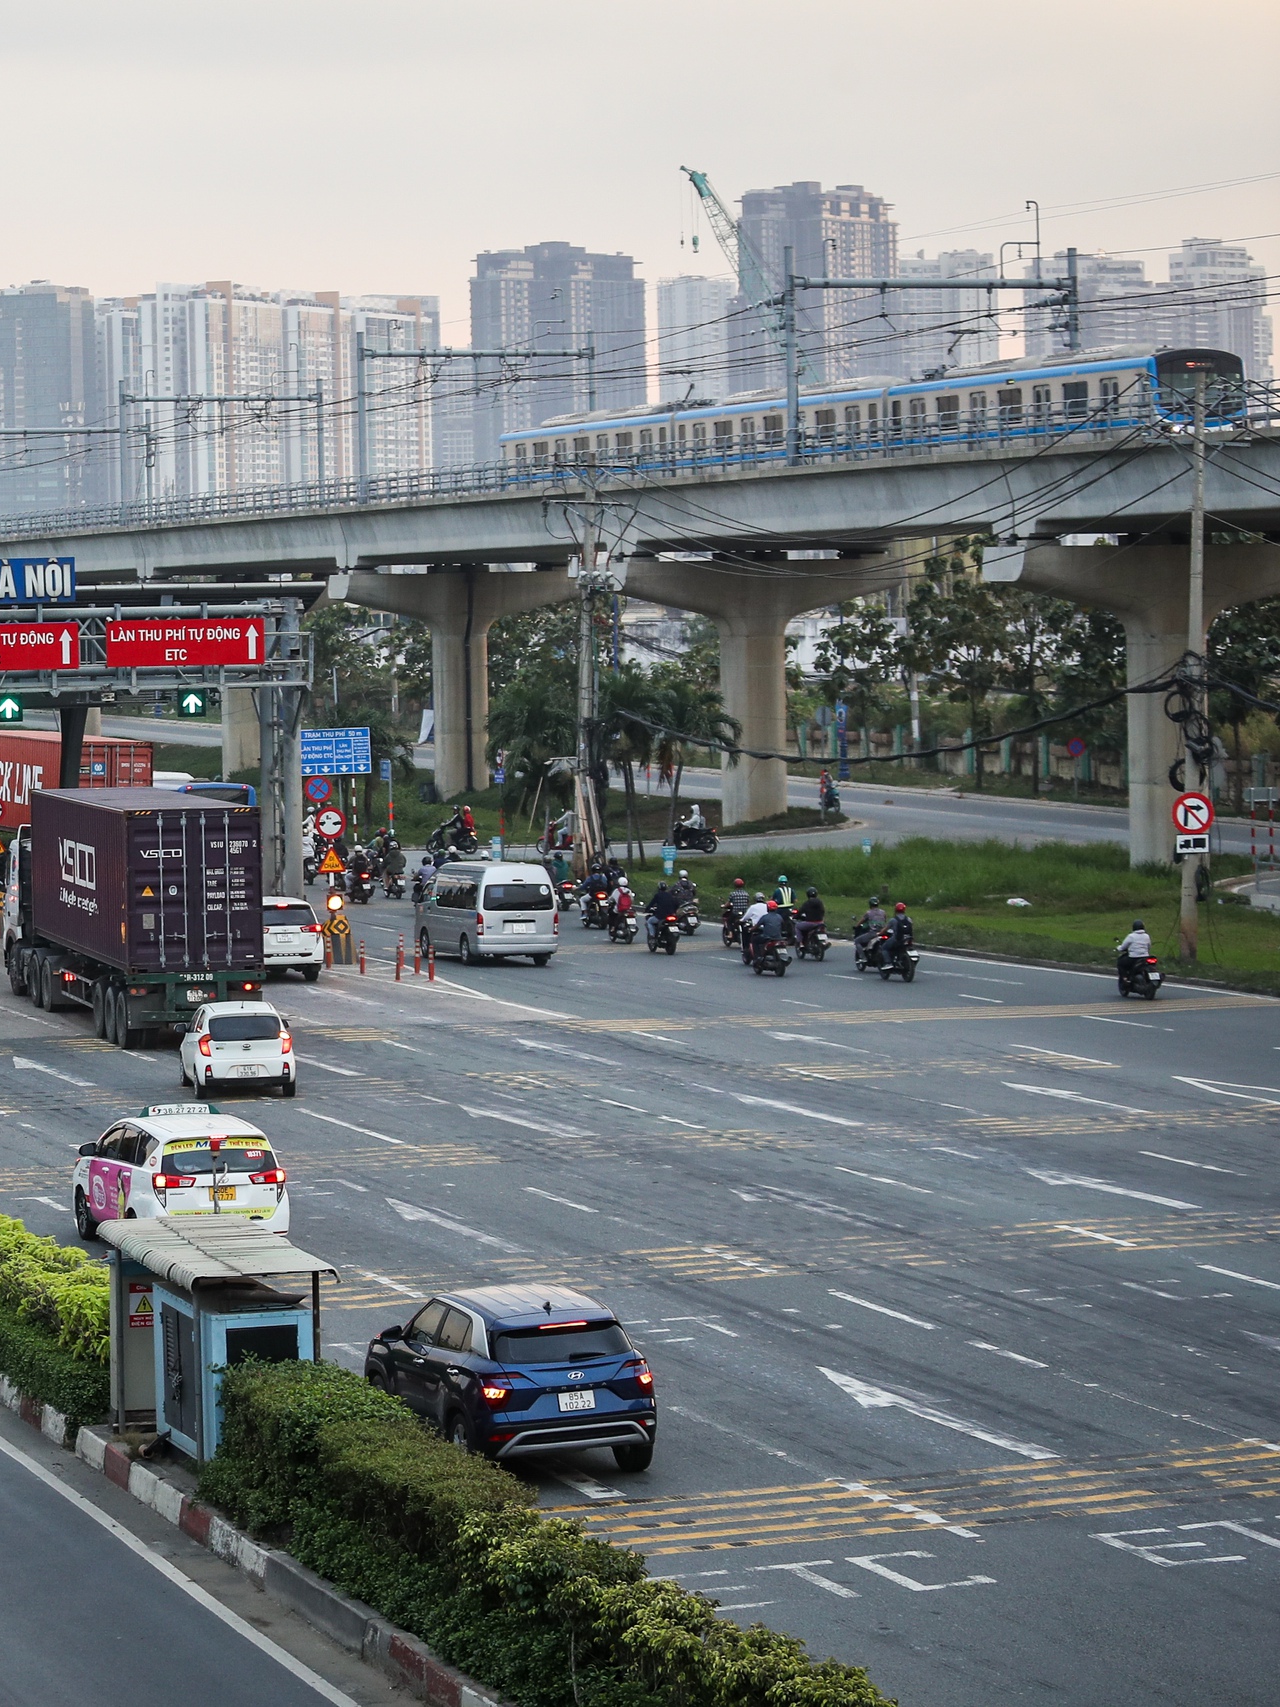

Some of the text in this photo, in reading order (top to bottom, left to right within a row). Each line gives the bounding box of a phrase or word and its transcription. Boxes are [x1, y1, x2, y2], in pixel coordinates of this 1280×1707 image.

[25, 558, 72, 602] NỘI
[1, 632, 18, 648] TỰ
[20, 630, 55, 647] ĐỘNG
[110, 625, 241, 643] LÀN THU PHÍ TỰ ĐỘNG
[165, 648, 188, 661] ETC
[206, 891, 225, 899] PAYLOAD
[180, 973, 205, 981] R-312
[195, 1140, 227, 1149] ME
[546, 1381, 607, 1392] CRETA
[568, 1392, 585, 1401] 85A
[565, 1400, 591, 1410] 102.22
